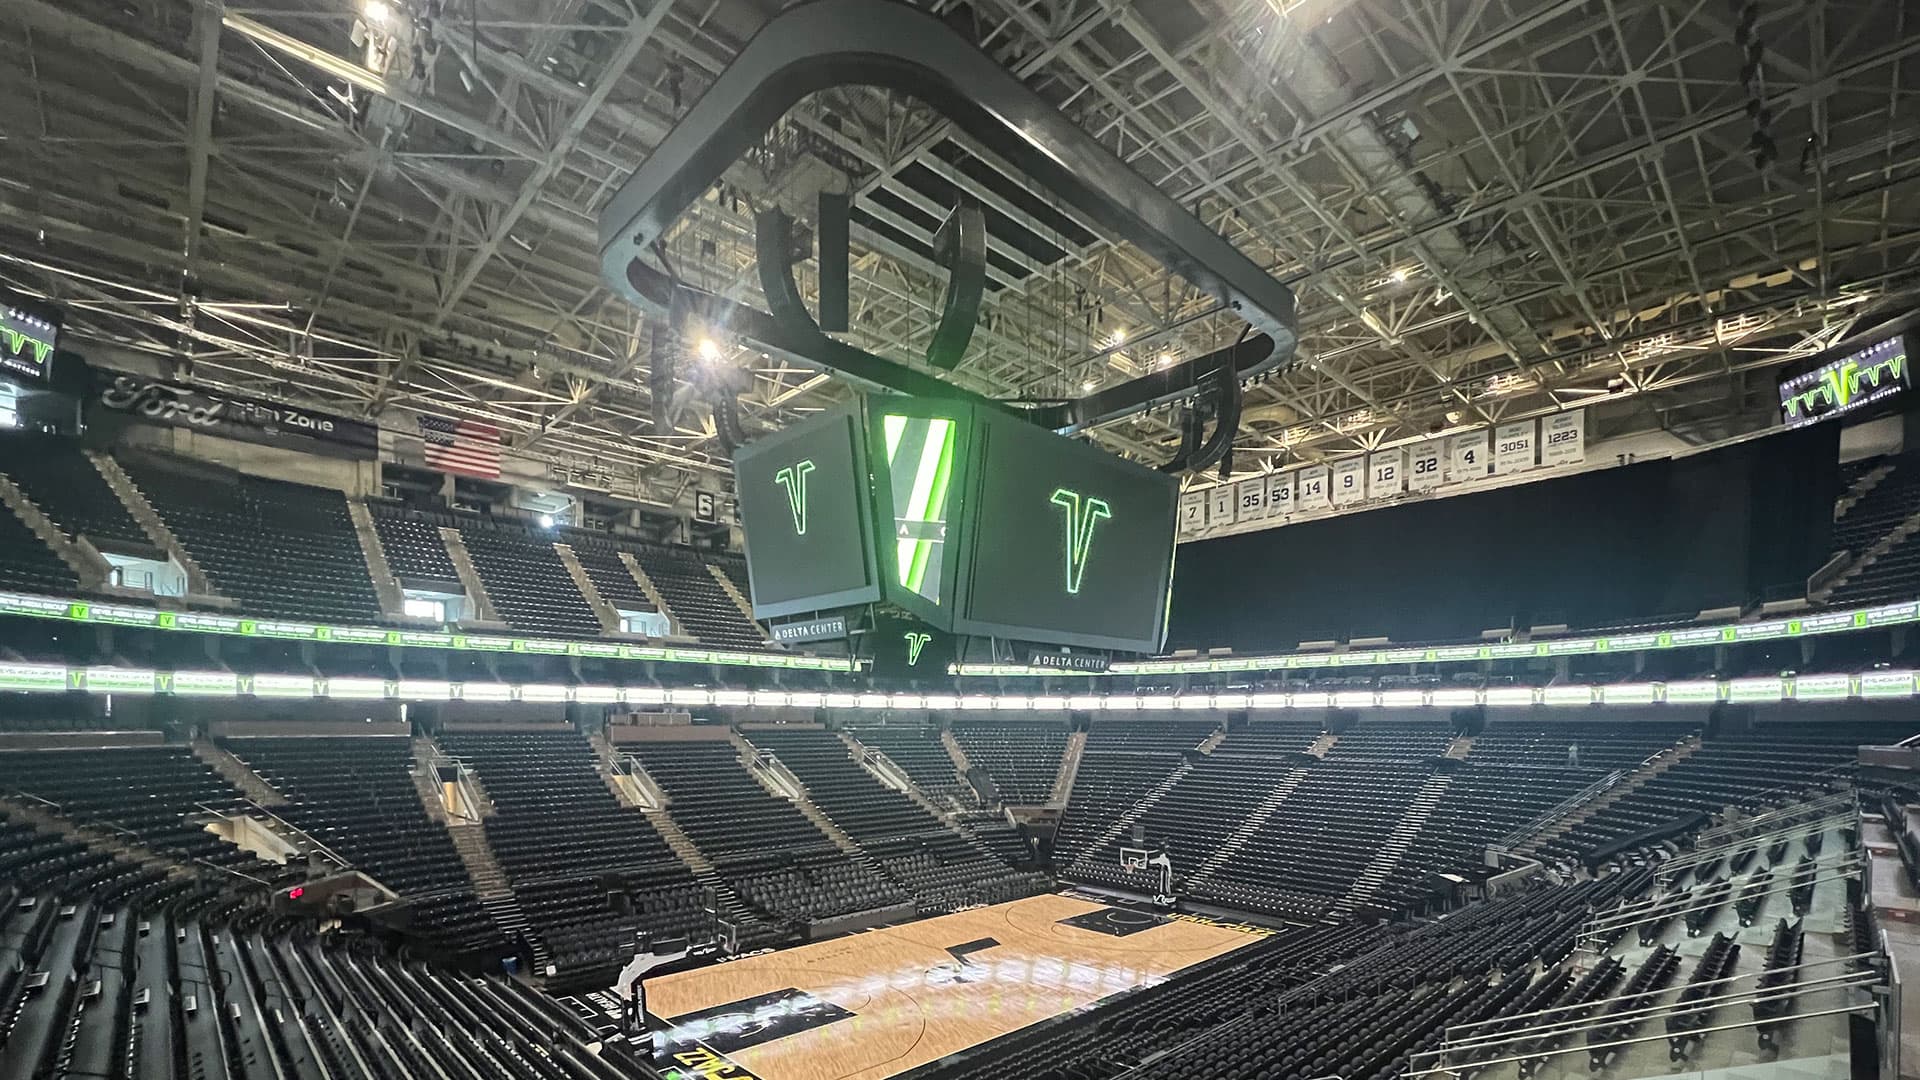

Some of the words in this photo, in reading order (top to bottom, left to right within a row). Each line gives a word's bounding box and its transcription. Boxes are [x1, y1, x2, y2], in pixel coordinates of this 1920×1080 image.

[102, 377, 223, 427] Ford
[284, 410, 334, 432] Zone
[1548, 429, 1578, 444] 1223
[1500, 439, 1529, 453] 3051
[1463, 450, 1475, 464] 4
[1415, 458, 1437, 475] 32
[1344, 475, 1353, 488] 9
[1376, 467, 1394, 482] 12
[1271, 488, 1289, 502] 53
[1305, 481, 1321, 495] 14
[698, 494, 712, 516] 6
[1218, 501, 1225, 513] 1
[1243, 494, 1260, 508] 35
[1188, 507, 1197, 519] 7
[782, 626, 809, 639] DELTA
[810, 621, 843, 635] CENTER
[1043, 656, 1072, 668] DELTA
[1074, 658, 1105, 669] CENTER
